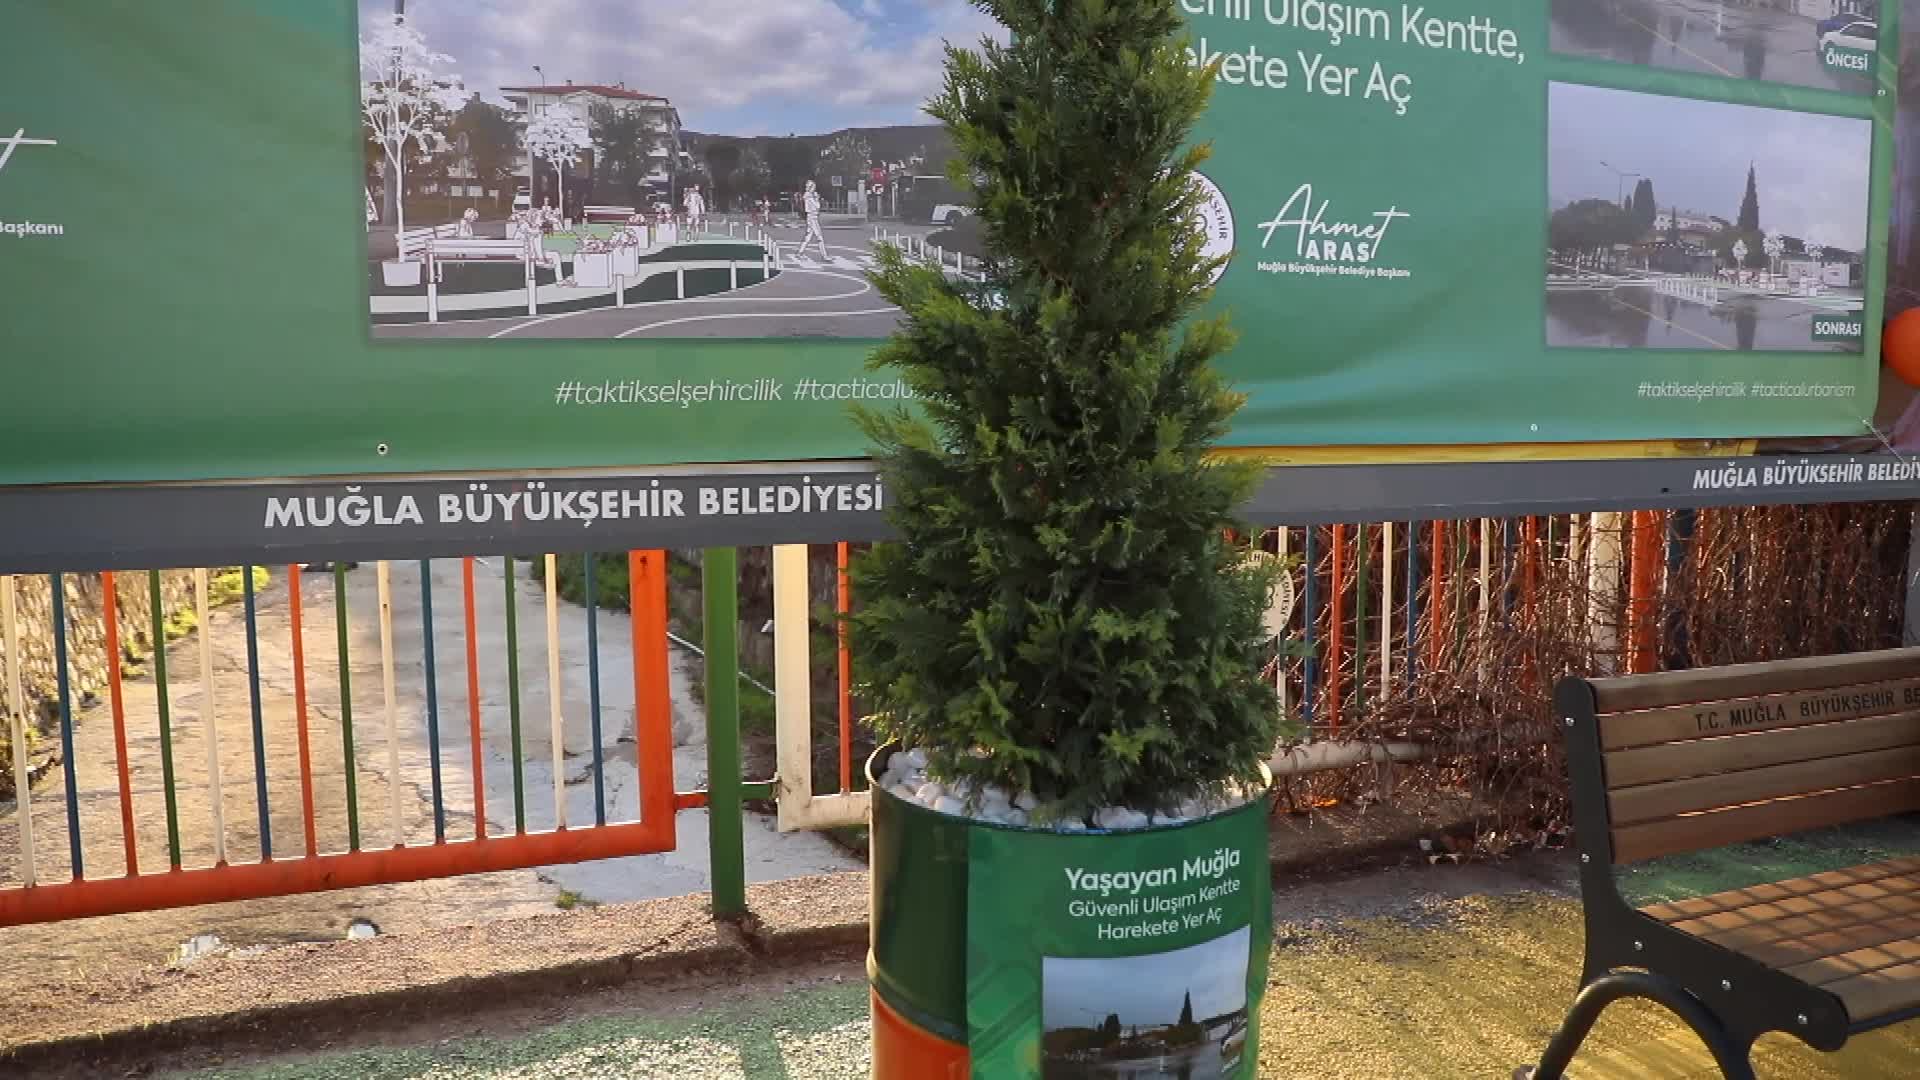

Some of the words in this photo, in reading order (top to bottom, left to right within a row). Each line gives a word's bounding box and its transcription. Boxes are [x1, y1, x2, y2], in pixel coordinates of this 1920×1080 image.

[1402, 6, 1525, 65] Kentte,
[1297, 50, 1358, 97] Yer
[1364, 62, 1412, 115] Aç
[0, 220, 64, 238] aşkanı
[1257, 183, 1410, 258] Ahmet
[1305, 239, 1369, 262] ARAS
[1815, 321, 1862, 336] SONRASI
[554, 378, 783, 409] #taktikselşehircilik
[1692, 461, 1757, 489] MUĞLA
[264, 485, 424, 527] MUĞLA
[438, 479, 685, 528] BÜYÜKŞEHİR
[699, 475, 882, 515] BELEDİYESİ
[1064, 867, 1177, 897] Yaşayan
[1183, 847, 1241, 881] Muğla
[1069, 898, 1139, 918] Güvenli
[1143, 893, 1196, 914] Ulaşım
[1200, 878, 1241, 903] Kentte
[1097, 918, 1179, 941] Harekete
[1182, 912, 1205, 929] Yer
[1205, 906, 1223, 925] Aç
